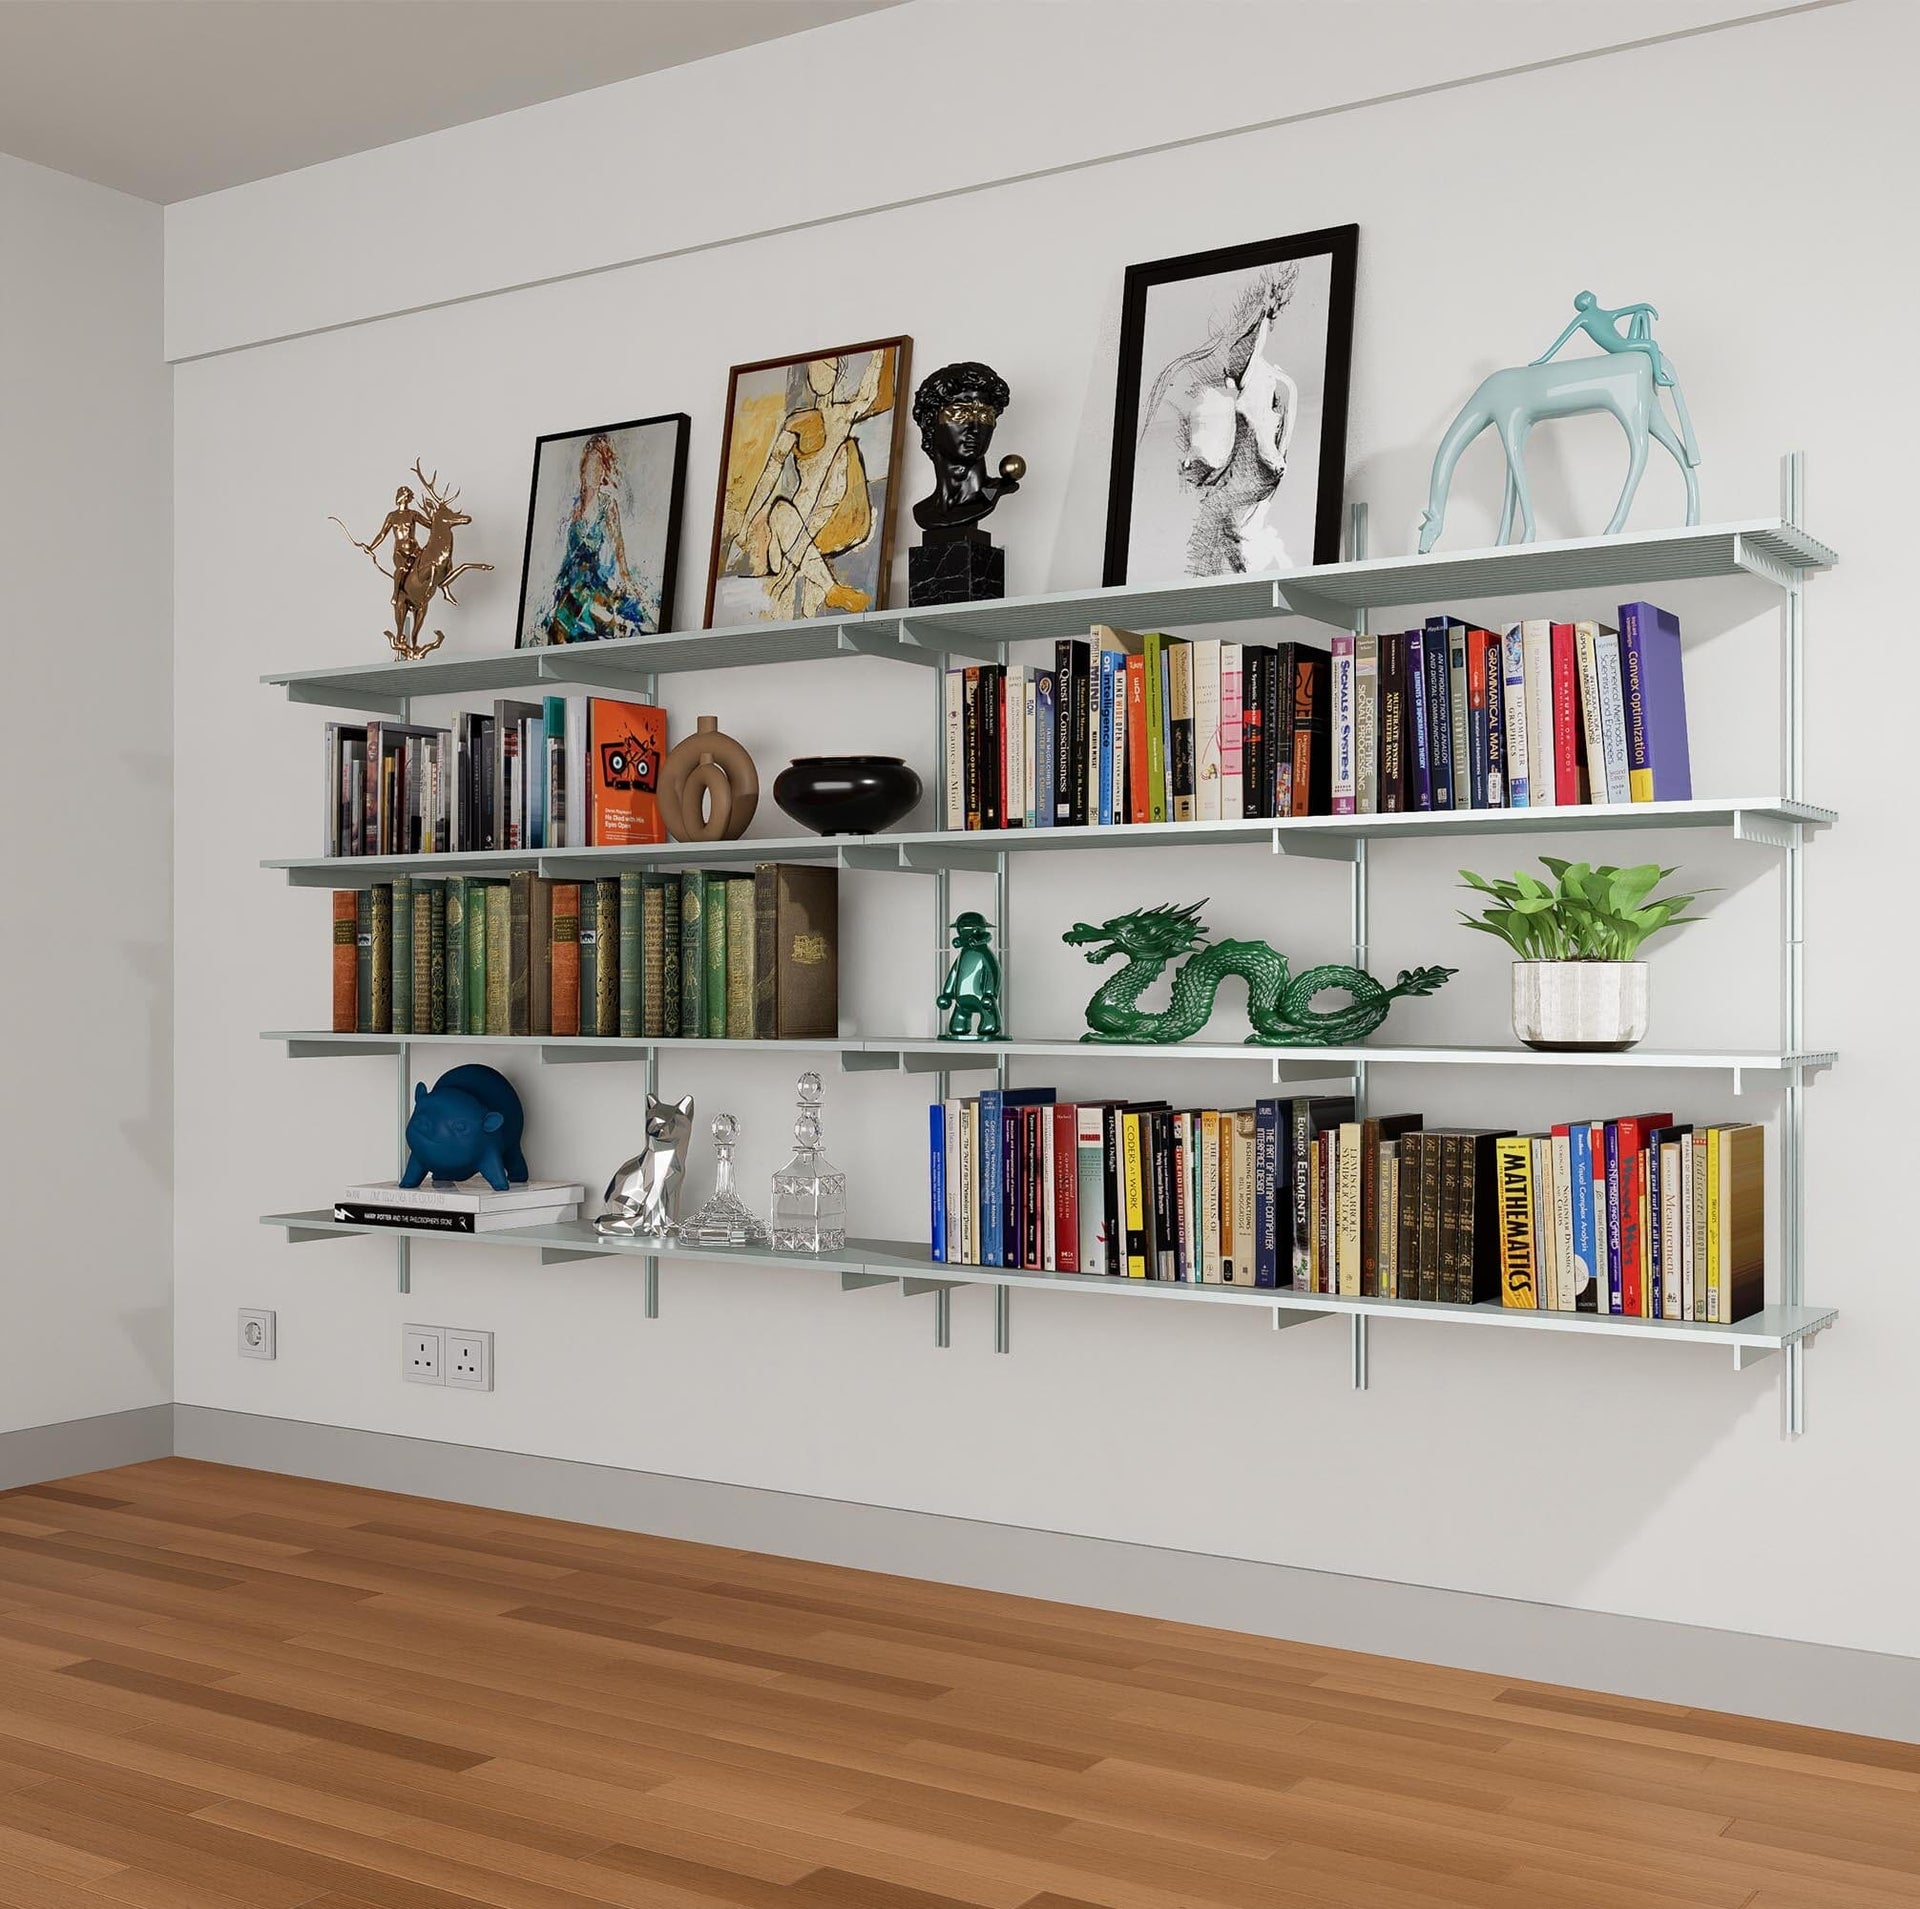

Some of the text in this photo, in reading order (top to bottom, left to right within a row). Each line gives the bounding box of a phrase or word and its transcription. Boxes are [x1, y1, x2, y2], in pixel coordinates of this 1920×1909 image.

[1091, 665, 1099, 712] MIND
[1101, 656, 1112, 747] on intelligence
[1341, 660, 1350, 711] SIGNALS
[1438, 652, 1444, 664] AN
[1441, 722, 1446, 732] TO
[1516, 696, 1523, 707] 3D
[1610, 654, 1621, 702] Numerical
[970, 719, 976, 728] OF
[1488, 648, 1498, 760] GRAMMATICAL MAN
[1600, 654, 1615, 764] Scientists and Engineers
[1612, 704, 1623, 747] Methods
[1628, 651, 1645, 764] Convex Optimization
[1060, 668, 1070, 792] Quest Consciousness
[1341, 725, 1350, 780] SYSTEMS
[1432, 699, 1440, 766] COMMUNICATIONS
[1565, 728, 1570, 740] OF
[951, 768, 957, 778] of
[1616, 750, 1625, 762] for
[1127, 1126, 1136, 1164] CODERS
[1266, 1128, 1274, 1141] THE
[1266, 1144, 1274, 1159] ART
[1266, 1162, 1274, 1172] OF
[1609, 1169, 1618, 1205] NUMBERS
[1686, 1165, 1691, 1173] OF
[1176, 1145, 1184, 1244] SUPERDISTRIBUTION
[1297, 1161, 1307, 1223] ELEMENTS
[1382, 1204, 1388, 1214] OF
[1578, 1162, 1588, 1252] Visual Complex Analysis
[1622, 1155, 1638, 1265] Winning Ways
[1696, 1154, 1705, 1260] Indiscrete Thoughts
[1211, 1222, 1216, 1234] OF
[1504, 1154, 1531, 1292] MATHEMATICS
[1610, 1221, 1619, 1249] GAMES
[1665, 1194, 1676, 1275] Measurement
